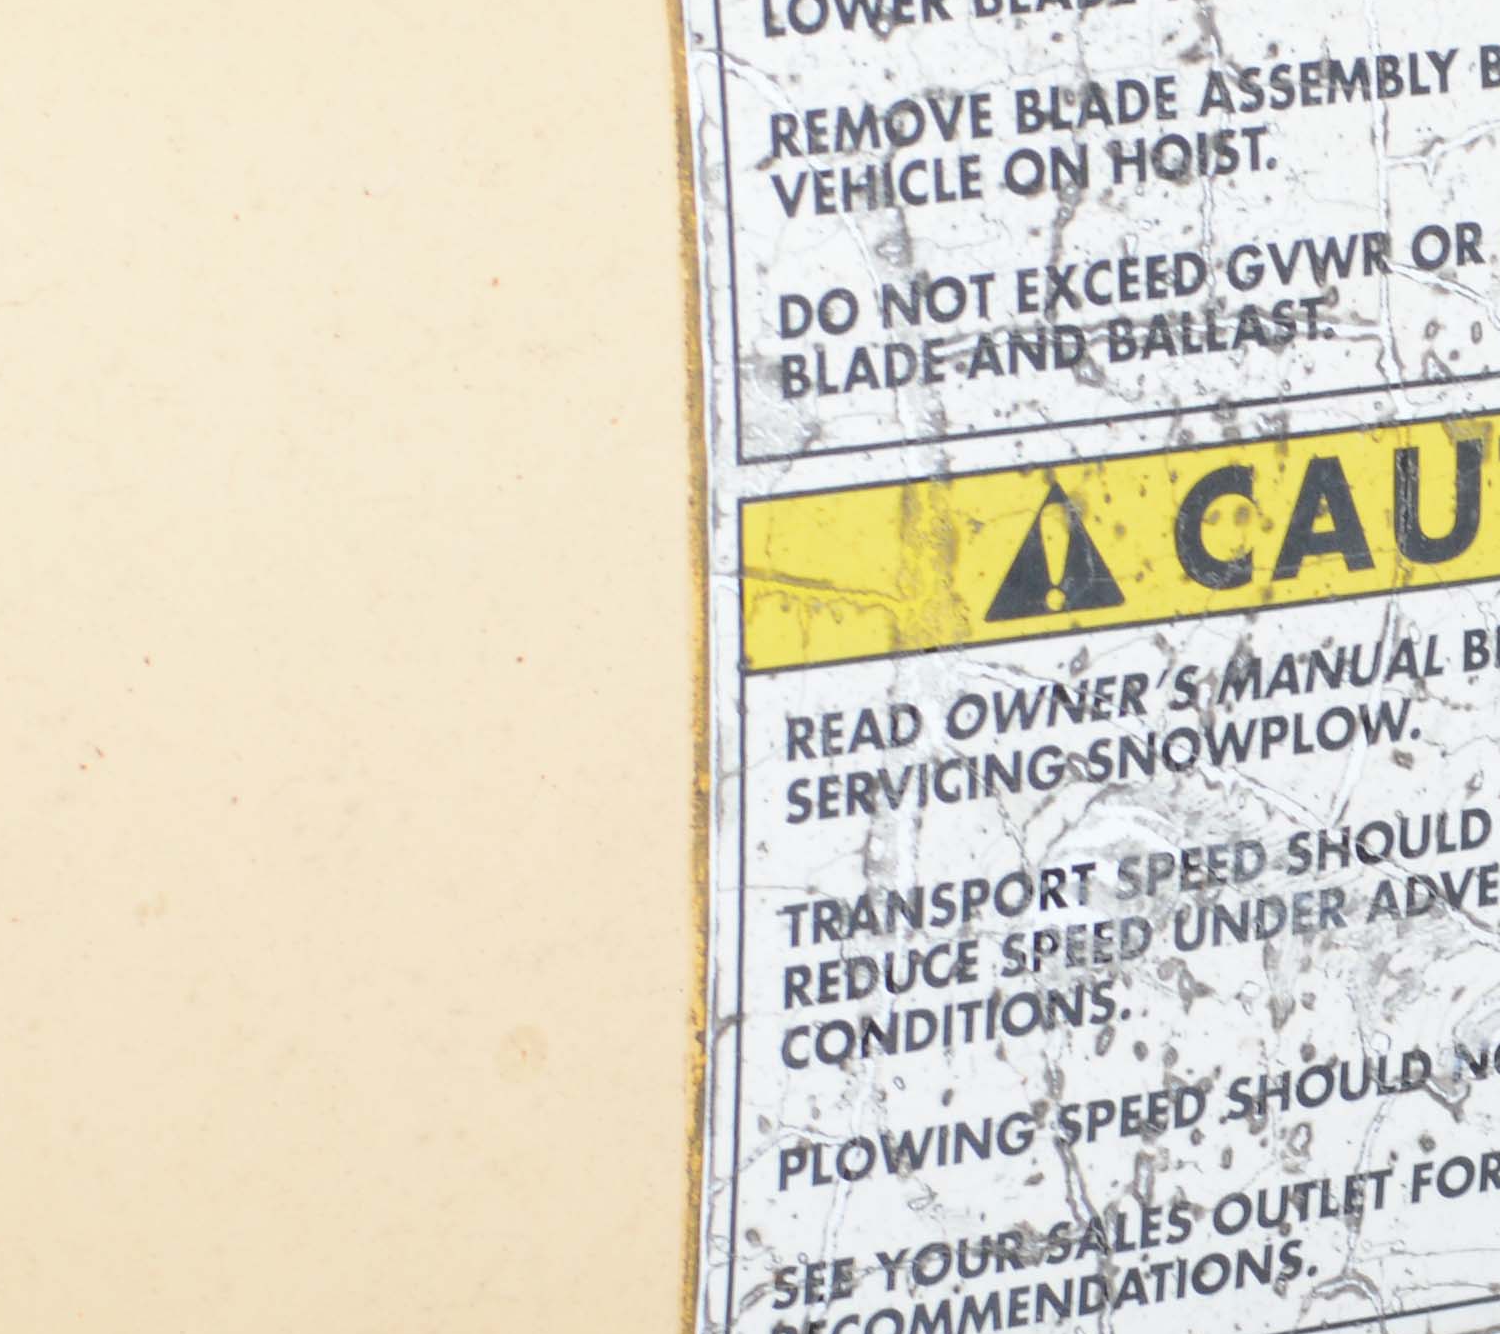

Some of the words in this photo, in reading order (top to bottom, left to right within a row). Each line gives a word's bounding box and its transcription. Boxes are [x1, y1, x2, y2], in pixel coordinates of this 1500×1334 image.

[770, 94, 993, 159] REMOVE
[1016, 76, 1177, 134] BLADE
[1200, 49, 1457, 117] ASSEMBLY
[772, 155, 982, 218] VEHICLE
[1004, 144, 1089, 195] ON
[1112, 127, 1277, 183] HOIST.
[780, 289, 859, 339] DO
[882, 273, 995, 329] NOT
[1017, 251, 1206, 314] EXCEED
[1227, 232, 1391, 291] GVWR
[1411, 222, 1484, 269] OR
[782, 339, 946, 399] BLADE
[968, 325, 1086, 379] AND
[1108, 297, 1334, 364] BALLAST.
[787, 703, 922, 761] READ
[946, 665, 1199, 741] OWNER'S
[1217, 635, 1444, 705] MANUAL
[787, 745, 1063, 824] SERVICING
[1087, 698, 1421, 784] SNOWPLOW.
[781, 863, 1096, 948] TRANSPORT
[1116, 840, 1267, 900] SPEED
[1287, 807, 1491, 870] SHOULD
[784, 941, 979, 1010] REDUCE
[1001, 917, 1153, 978] SPEED
[1174, 888, 1347, 952] UNDER
[780, 980, 1131, 1069] CONDITIONS.
[779, 1112, 1034, 1191] PLOWING
[1058, 1085, 1206, 1145] SPEED
[1226, 1051, 1431, 1120] SHOULD
[773, 1257, 855, 1310] SEE
[875, 1230, 1023, 1293] YOUR
[1047, 1203, 1192, 1265] SALES
[1213, 1168, 1394, 1237] OUTLET
